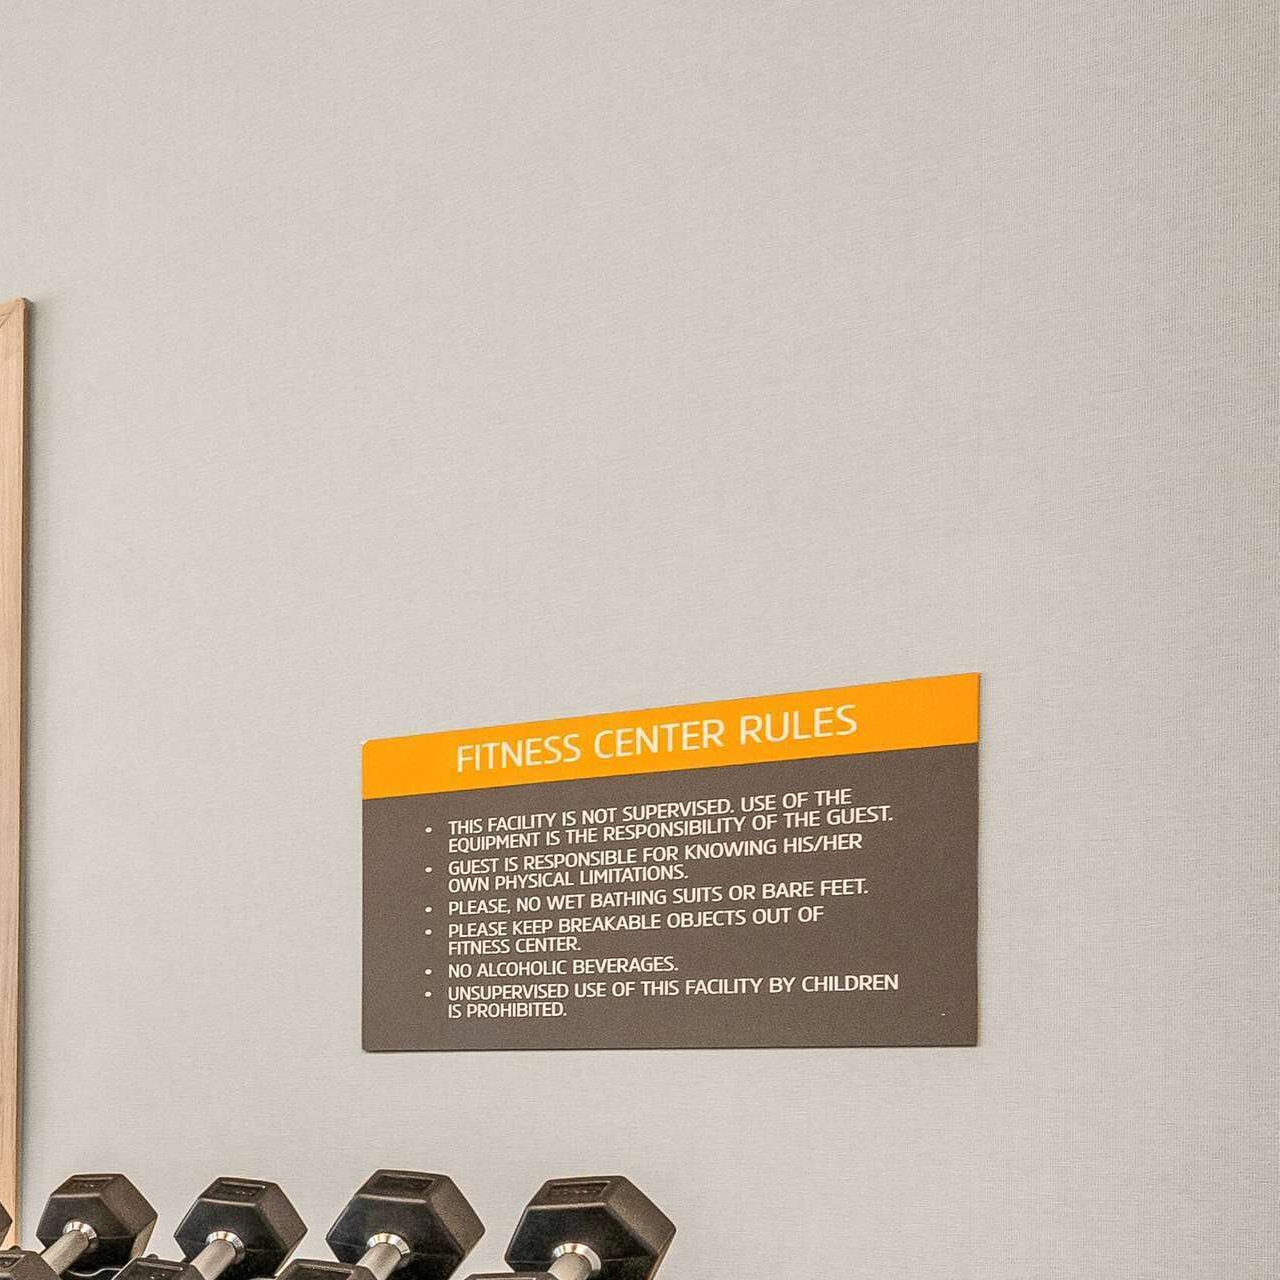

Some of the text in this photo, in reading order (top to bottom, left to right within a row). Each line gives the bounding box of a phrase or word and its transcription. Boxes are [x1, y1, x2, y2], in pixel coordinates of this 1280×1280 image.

[457, 704, 857, 772] FITNESS CENTER RULES
[447, 787, 852, 835] THIS FACILITY IS NOT SUPERVISED. USE OF THE
[447, 804, 893, 853] EQUIPMENT IS THE RESPONSIBILITY OF THE GUEST.
[447, 832, 863, 876] GUEST IS RESPONSIBLE FOR KNOWING HIS/HER
[447, 863, 689, 893] OWN PHYSICAL LIMITATIONS.
[447, 877, 869, 916] PLEASE, NO WET BATHING SUITS OR BARE FEET.
[447, 904, 824, 938] PLEASE KEEP BREAKABLE OBJECTS OUT OF
[447, 935, 581, 956] FITNESS CENTER.
[447, 955, 679, 979] NO ALCOHOLIC BEVERAGES.
[447, 973, 899, 1001] UNSUPERVISED USE OF THIS FACILITY BY CHILDREN
[447, 1000, 567, 1019] IS PROHIBITED.
